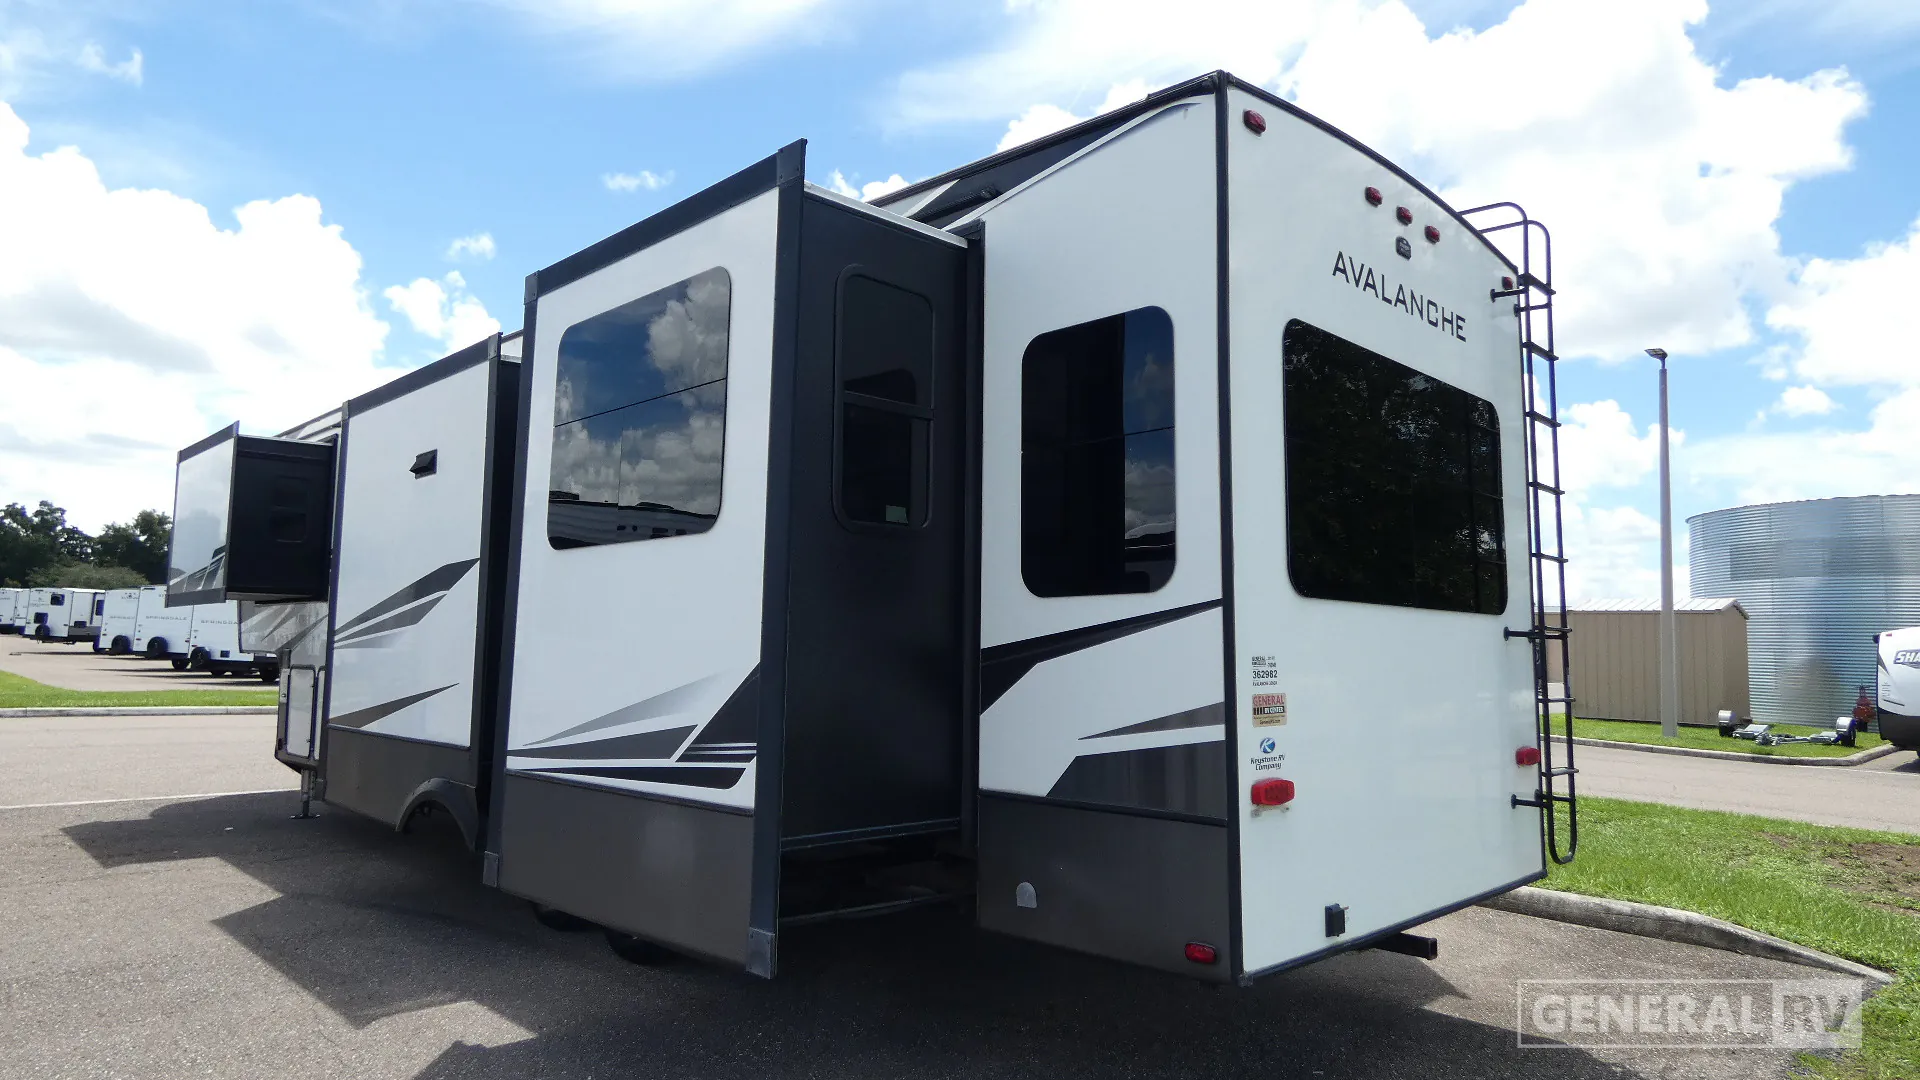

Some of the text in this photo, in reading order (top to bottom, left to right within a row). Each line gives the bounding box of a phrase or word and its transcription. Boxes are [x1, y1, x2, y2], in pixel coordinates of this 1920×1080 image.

[1332, 250, 1467, 343] AVALANCHE
[1252, 669, 1278, 679] 362982
[1253, 694, 1285, 707] GENERAL
[1250, 756, 1278, 765] Keystone
[1255, 762, 1282, 770] Company
